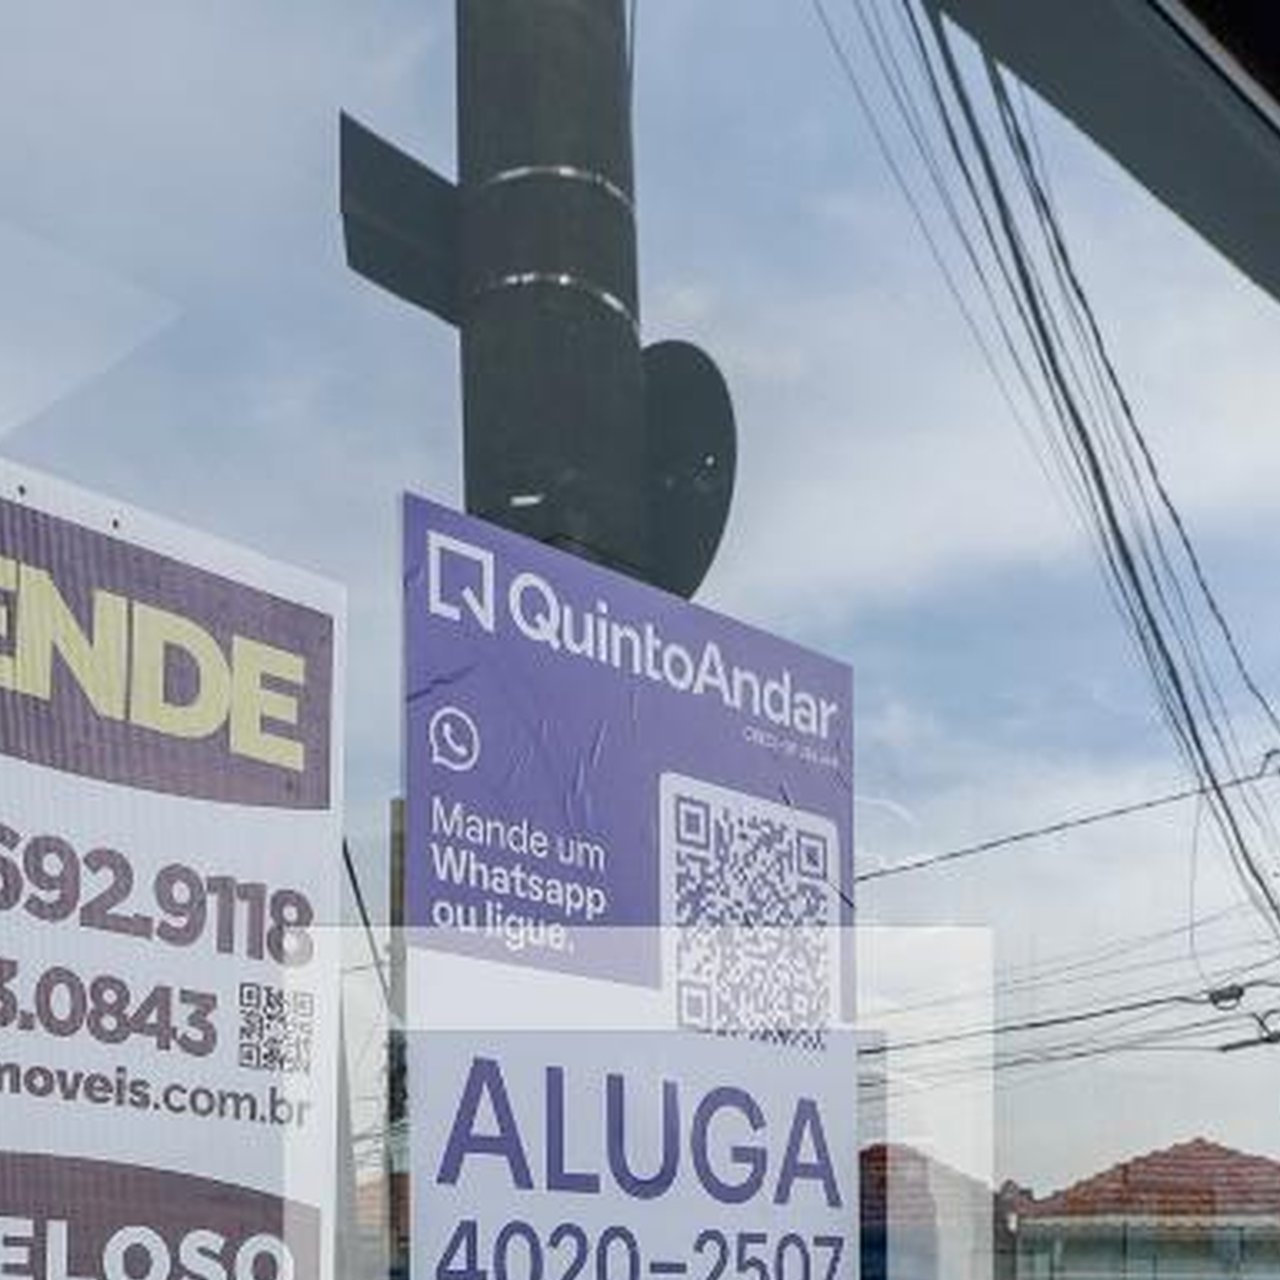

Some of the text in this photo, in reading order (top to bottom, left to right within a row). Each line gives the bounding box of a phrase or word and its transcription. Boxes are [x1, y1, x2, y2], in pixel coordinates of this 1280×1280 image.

[508, 572, 839, 741] QuintoAndar
[431, 797, 606, 873] Mande um
[430, 842, 608, 922] Whatsapp
[432, 901, 477, 932] ou
[436, 1055, 843, 1209] ALUGA
